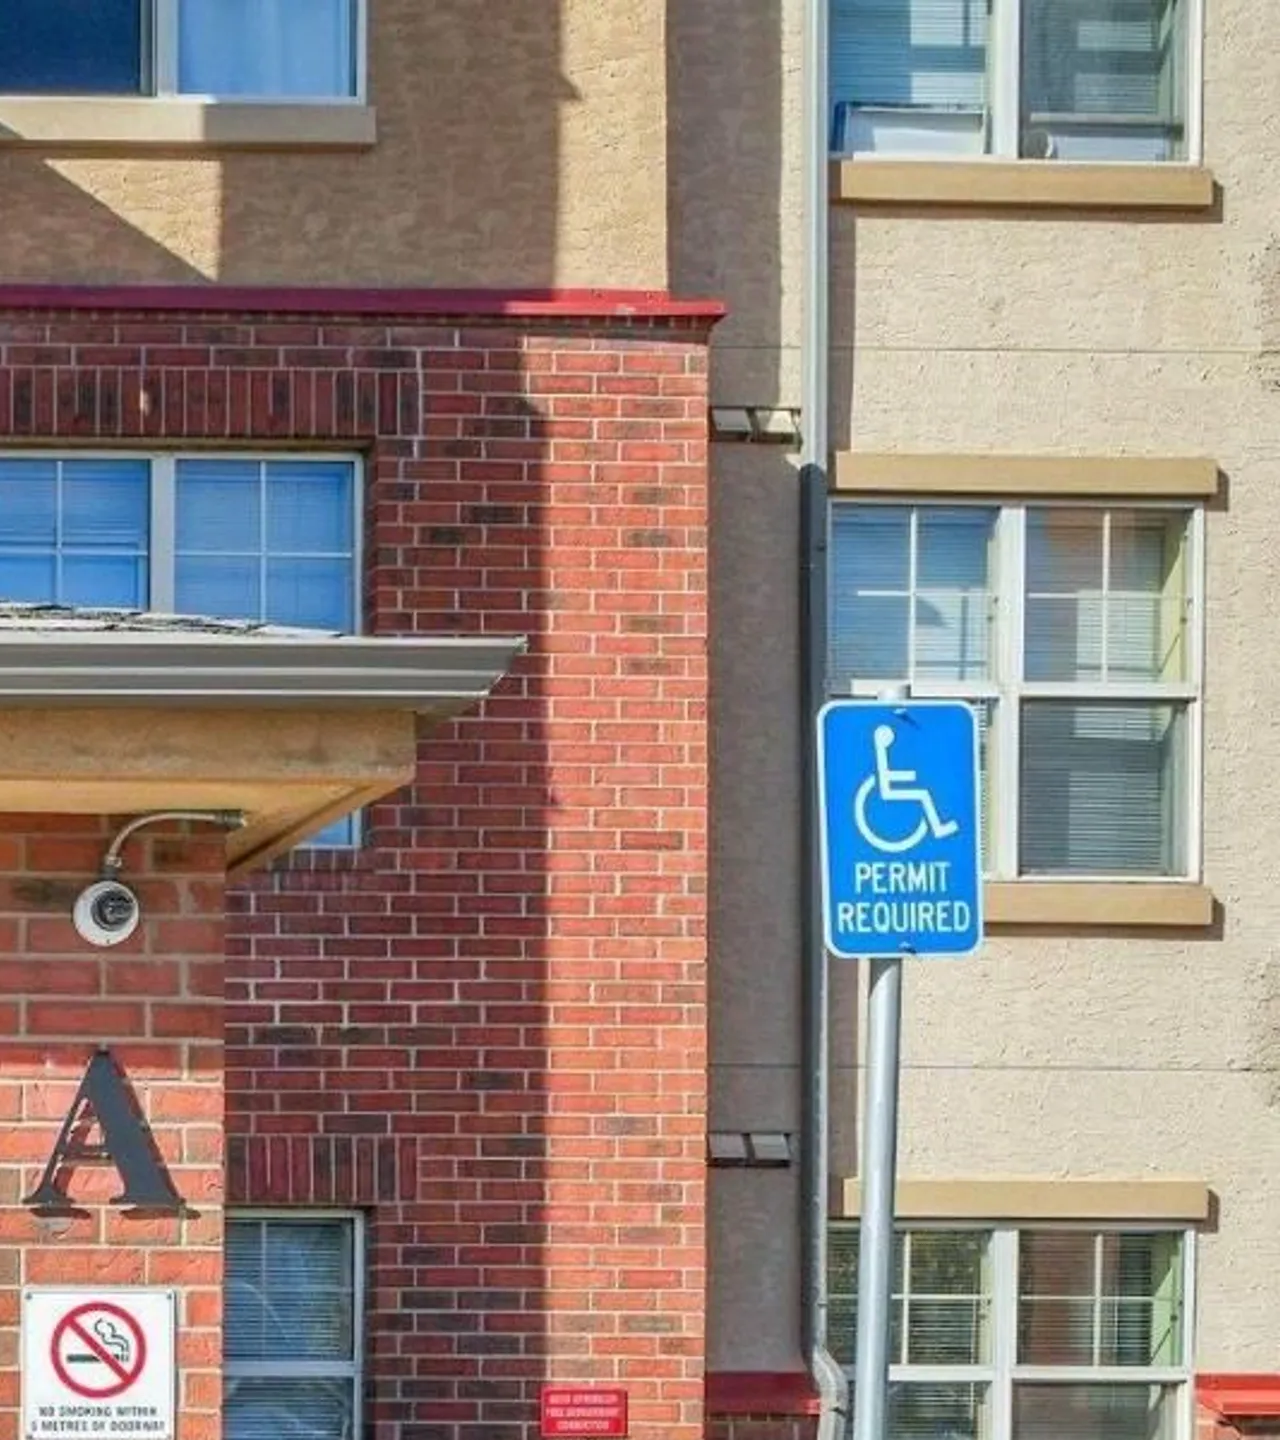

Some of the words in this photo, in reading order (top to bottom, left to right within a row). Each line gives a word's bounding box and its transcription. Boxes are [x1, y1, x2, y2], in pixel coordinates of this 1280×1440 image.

[855, 862, 951, 894] PERMIT
[838, 902, 970, 932] REQUIRED
[22, 1049, 187, 1206] A
[39, 1406, 55, 1417] NO
[58, 1406, 112, 1417] SMOKING
[116, 1406, 157, 1417] WITHIN
[41, 1421, 88, 1432] METRES
[92, 1421, 105, 1432] OF
